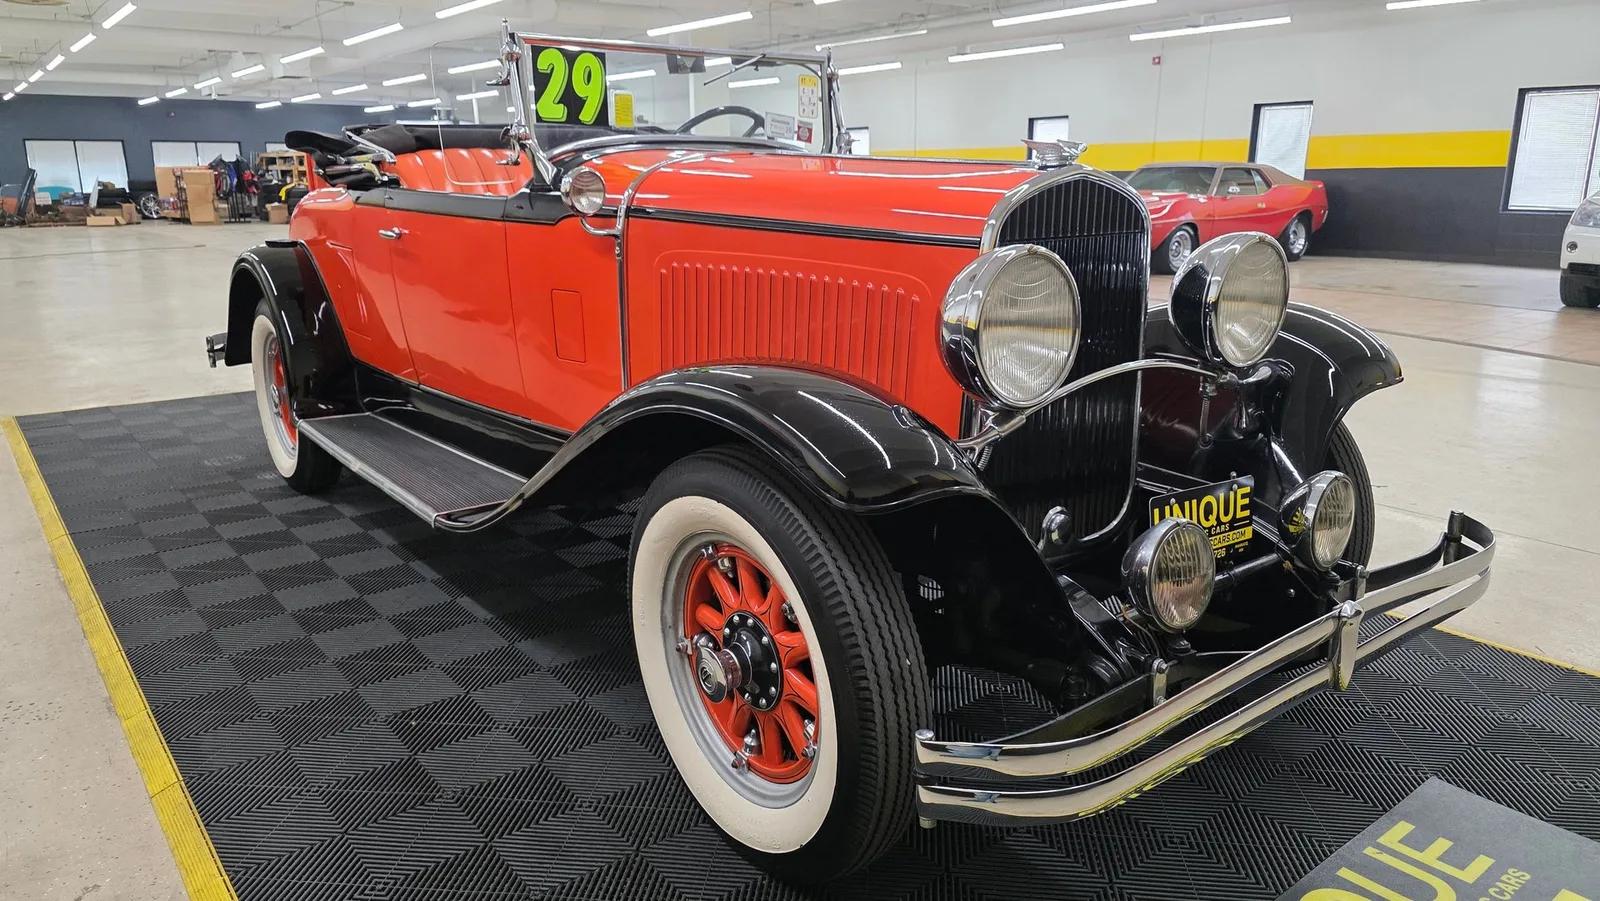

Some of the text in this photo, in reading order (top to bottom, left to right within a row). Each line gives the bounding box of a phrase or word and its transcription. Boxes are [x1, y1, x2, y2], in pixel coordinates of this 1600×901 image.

[536, 48, 604, 125] 29
[1153, 486, 1251, 528] UNIQUE
[1211, 523, 1230, 535] CARS
[1488, 867, 1531, 901] CARS
